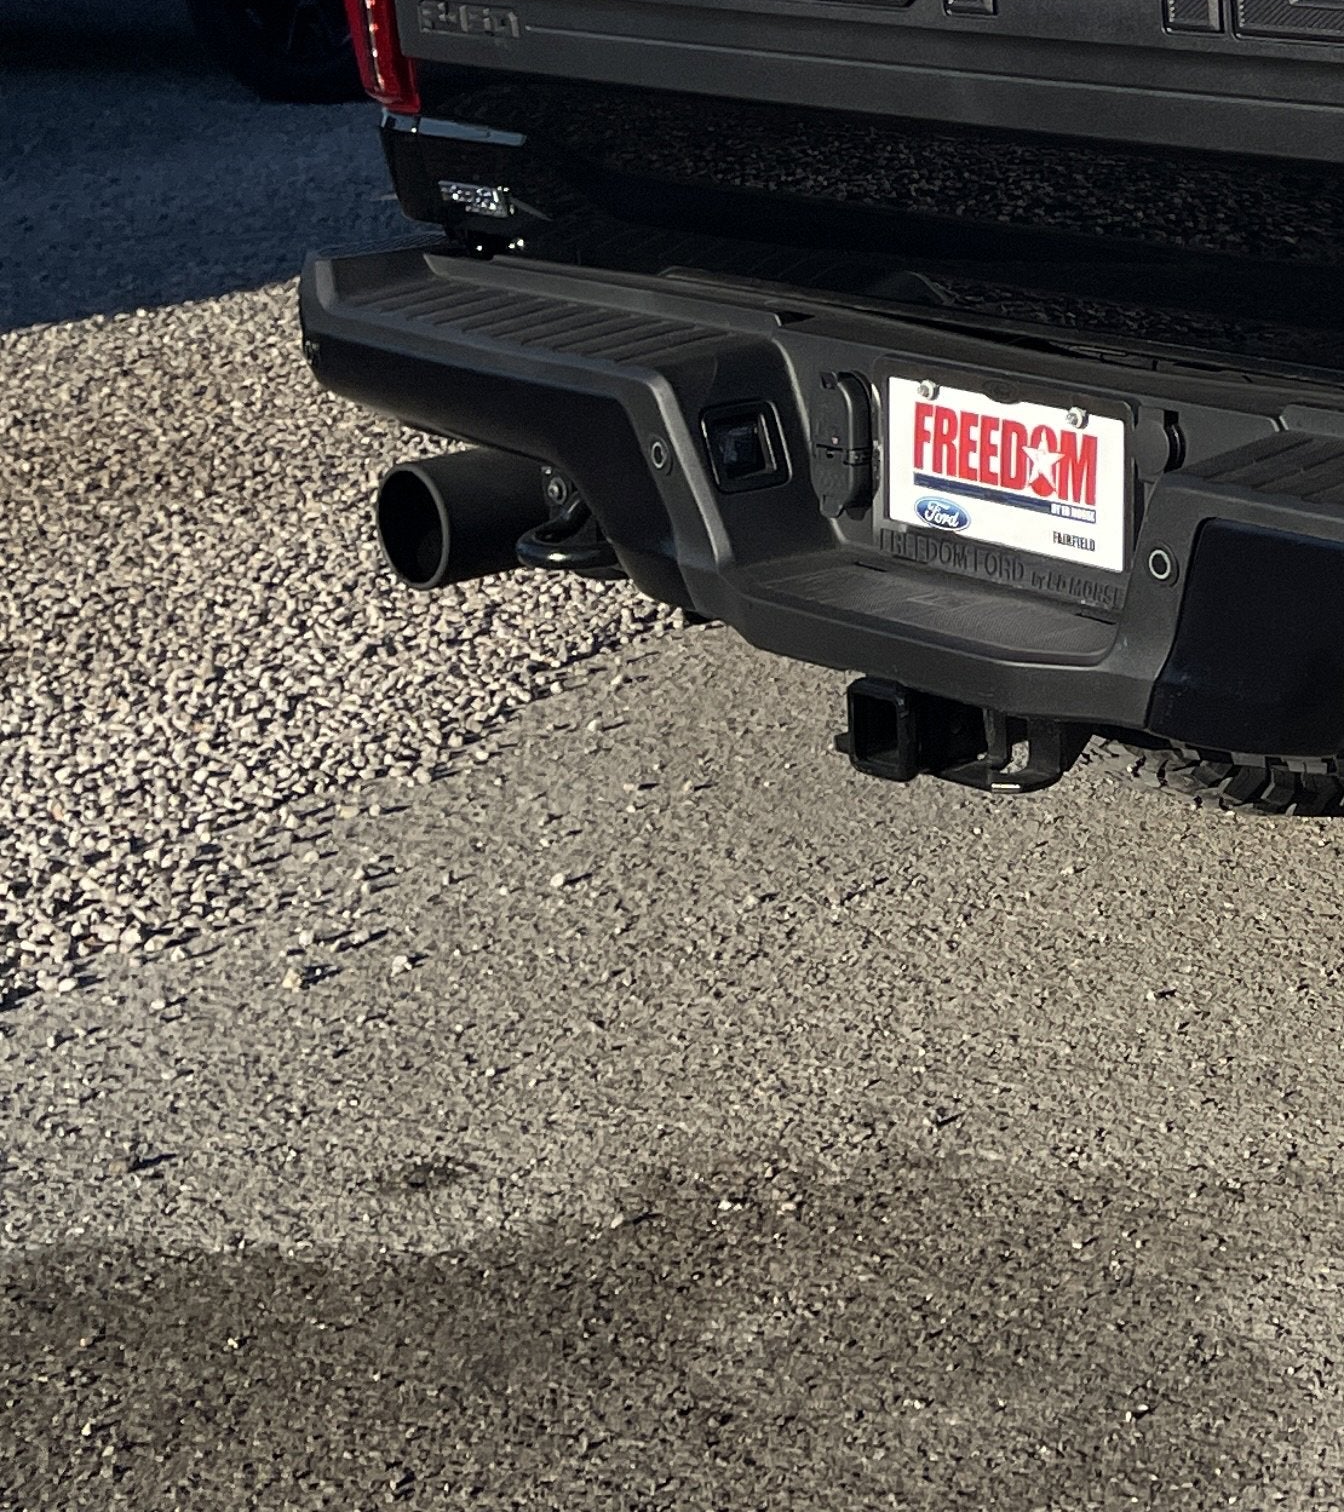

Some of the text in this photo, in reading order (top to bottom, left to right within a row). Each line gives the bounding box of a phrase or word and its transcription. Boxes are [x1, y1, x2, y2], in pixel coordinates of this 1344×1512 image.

[913, 402, 1098, 506] FREEDOM
[923, 502, 961, 529] Ford
[880, 528, 968, 571] FREEDOM
[974, 544, 1024, 581] FORD
[1053, 530, 1096, 552] FAIRFIELD
